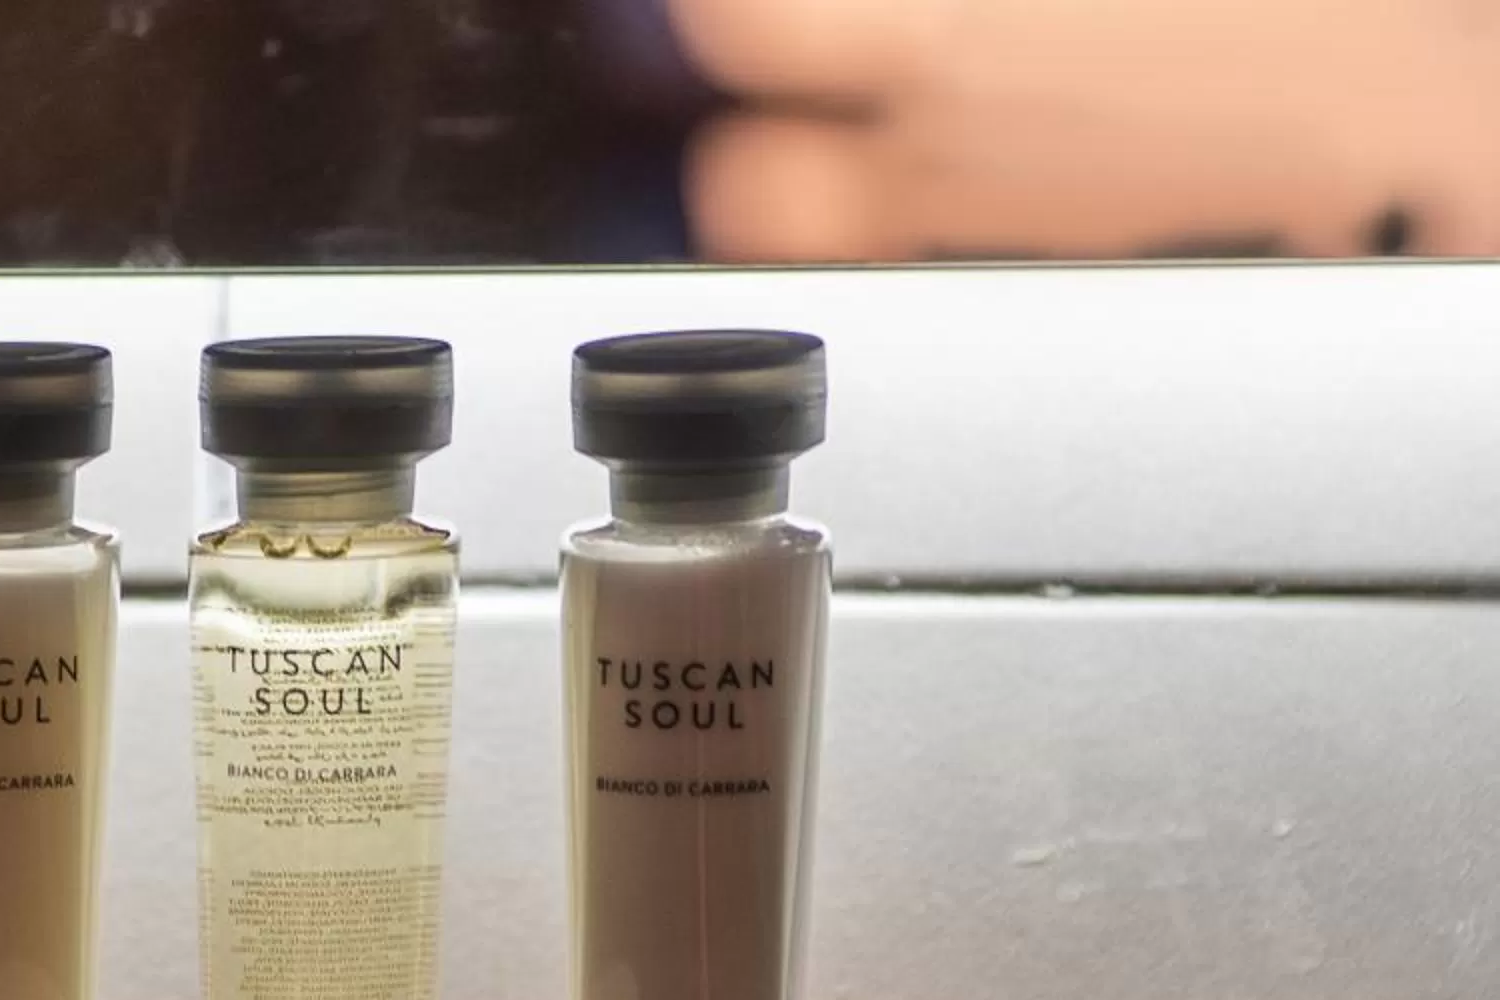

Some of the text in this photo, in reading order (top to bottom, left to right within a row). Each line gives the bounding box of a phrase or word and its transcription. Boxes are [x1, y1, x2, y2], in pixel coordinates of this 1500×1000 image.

[229, 645, 402, 676] TUSCAN
[597, 657, 774, 690] TUSCAN
[255, 687, 372, 715] SOUL
[624, 700, 745, 729] SOUL
[227, 763, 397, 783] BIANCO DI CARRARA
[596, 777, 771, 797] BIANCO DI CARRARA
